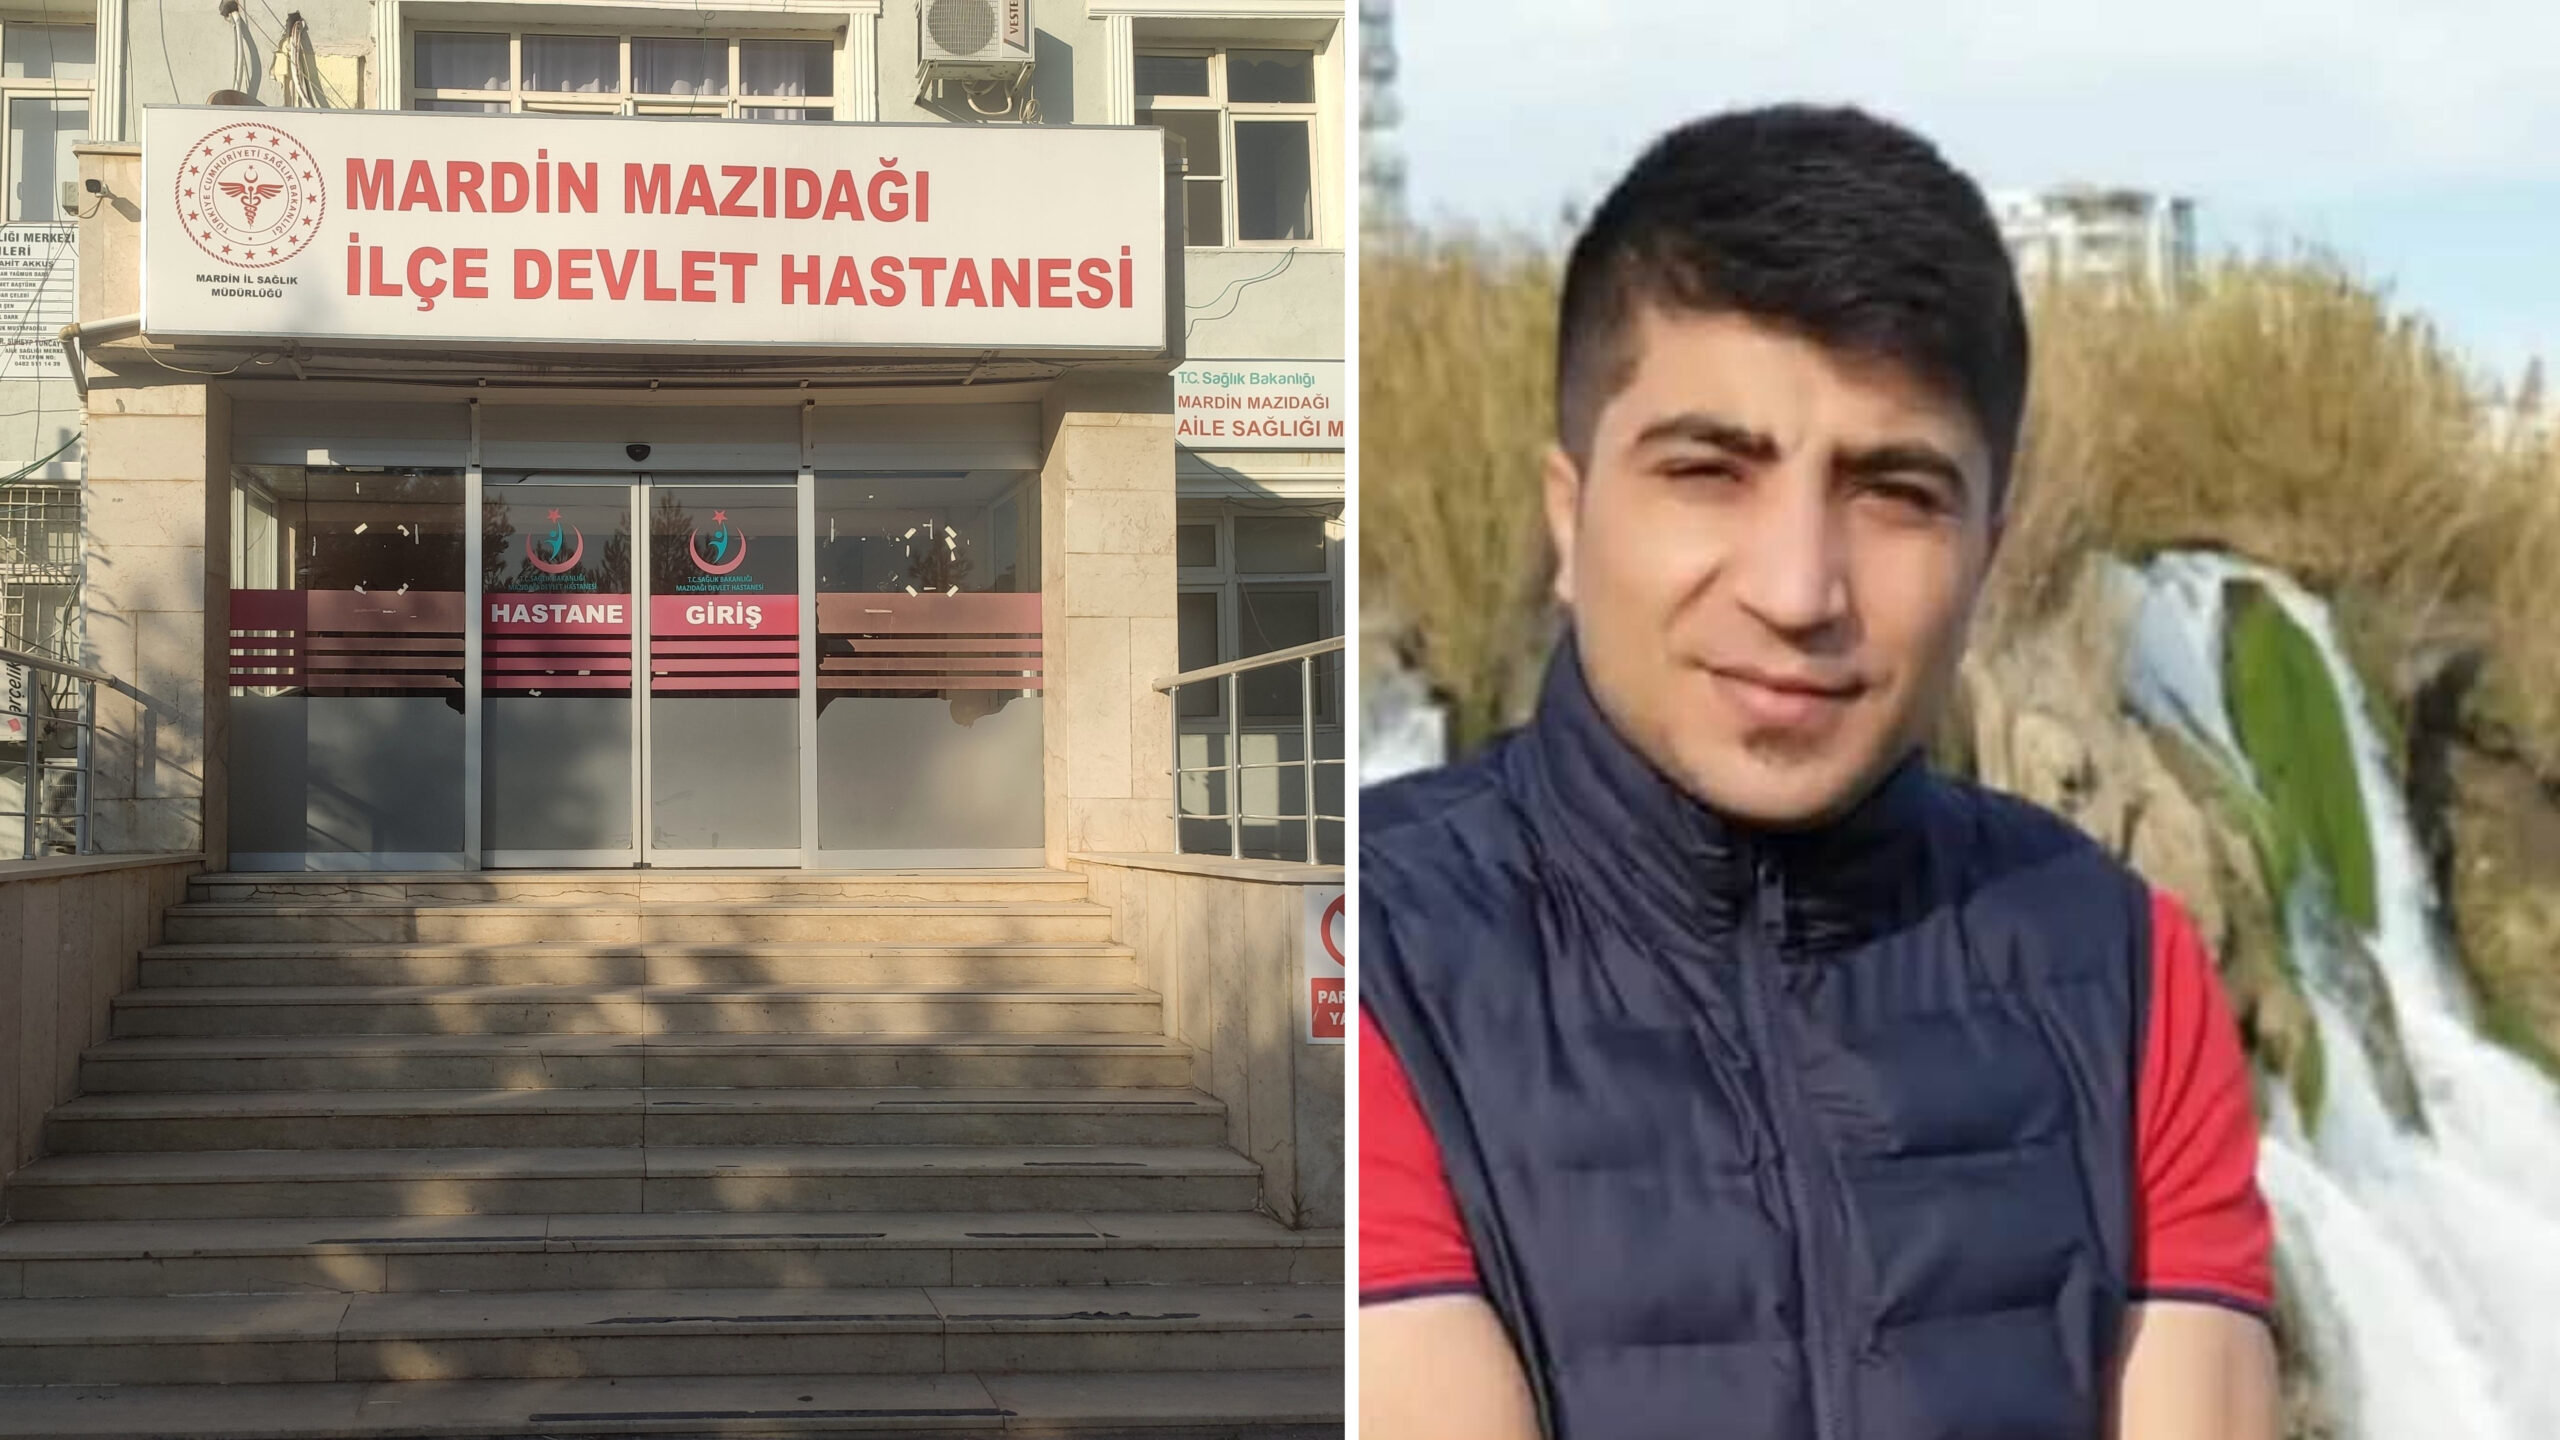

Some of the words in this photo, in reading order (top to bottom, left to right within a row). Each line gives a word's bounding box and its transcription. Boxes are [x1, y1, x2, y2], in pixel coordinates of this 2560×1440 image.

[204, 149, 261, 191] CUMHURİYETİ
[263, 153, 294, 182] SAĞLIK
[346, 148, 598, 214] MARDİN
[624, 156, 929, 222] MAZIDAĞI
[203, 195, 229, 234] TÜRKİYE
[272, 184, 298, 236] BAKANLIĞI
[24, 231, 75, 243] MERKEZİ
[0, 244, 31, 256] LERİ
[196, 273, 240, 283] MARDİN
[243, 273, 254, 284] İL
[257, 275, 298, 285] SAĞLIK
[346, 232, 489, 312] İLÇE
[514, 248, 758, 304] DEVLET
[781, 245, 1133, 308] HASTANESİ
[211, 287, 283, 298] MÜDÜRLÜĞÜ
[1178, 371, 1200, 384] T.C.
[1202, 371, 1245, 388] Sağlık
[1250, 372, 1315, 388] Bakanlığı
[1178, 393, 1242, 409] MARDİN
[1247, 393, 1329, 410] MAZIDAĞI
[1177, 415, 1225, 436] AİLE
[1232, 415, 1320, 437] SAĞLIĞI
[675, 583, 706, 592] MAZIDAĞI
[731, 583, 764, 591] HASTANESİ
[491, 603, 624, 624] HASTANE
[685, 601, 763, 630] GİRİŞ
